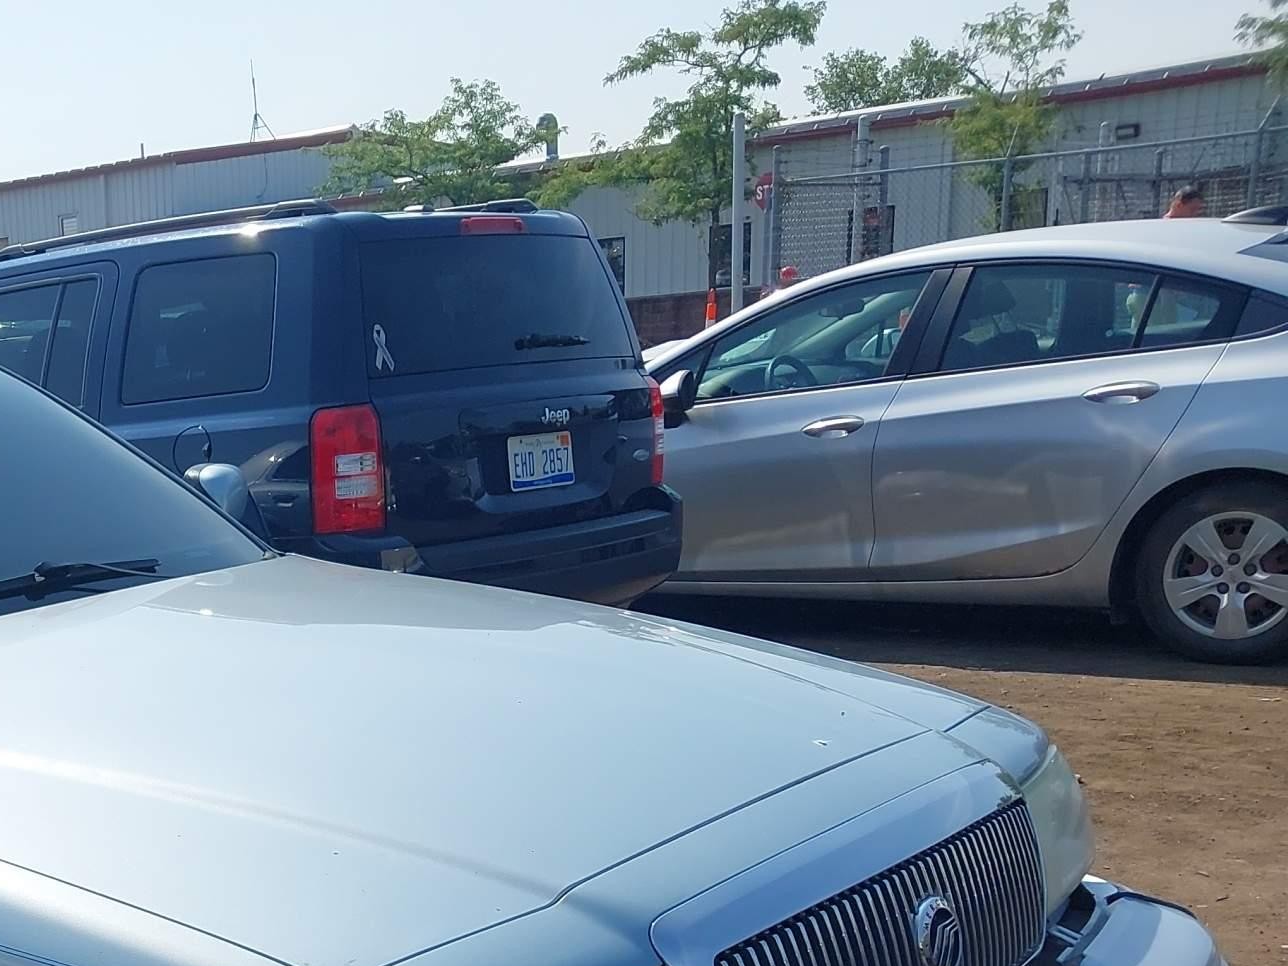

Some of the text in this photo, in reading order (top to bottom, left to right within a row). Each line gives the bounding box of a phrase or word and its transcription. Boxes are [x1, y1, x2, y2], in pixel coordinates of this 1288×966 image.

[756, 184, 773, 200] ST
[541, 407, 570, 425] Jeep
[513, 447, 569, 479] EHD 2857
